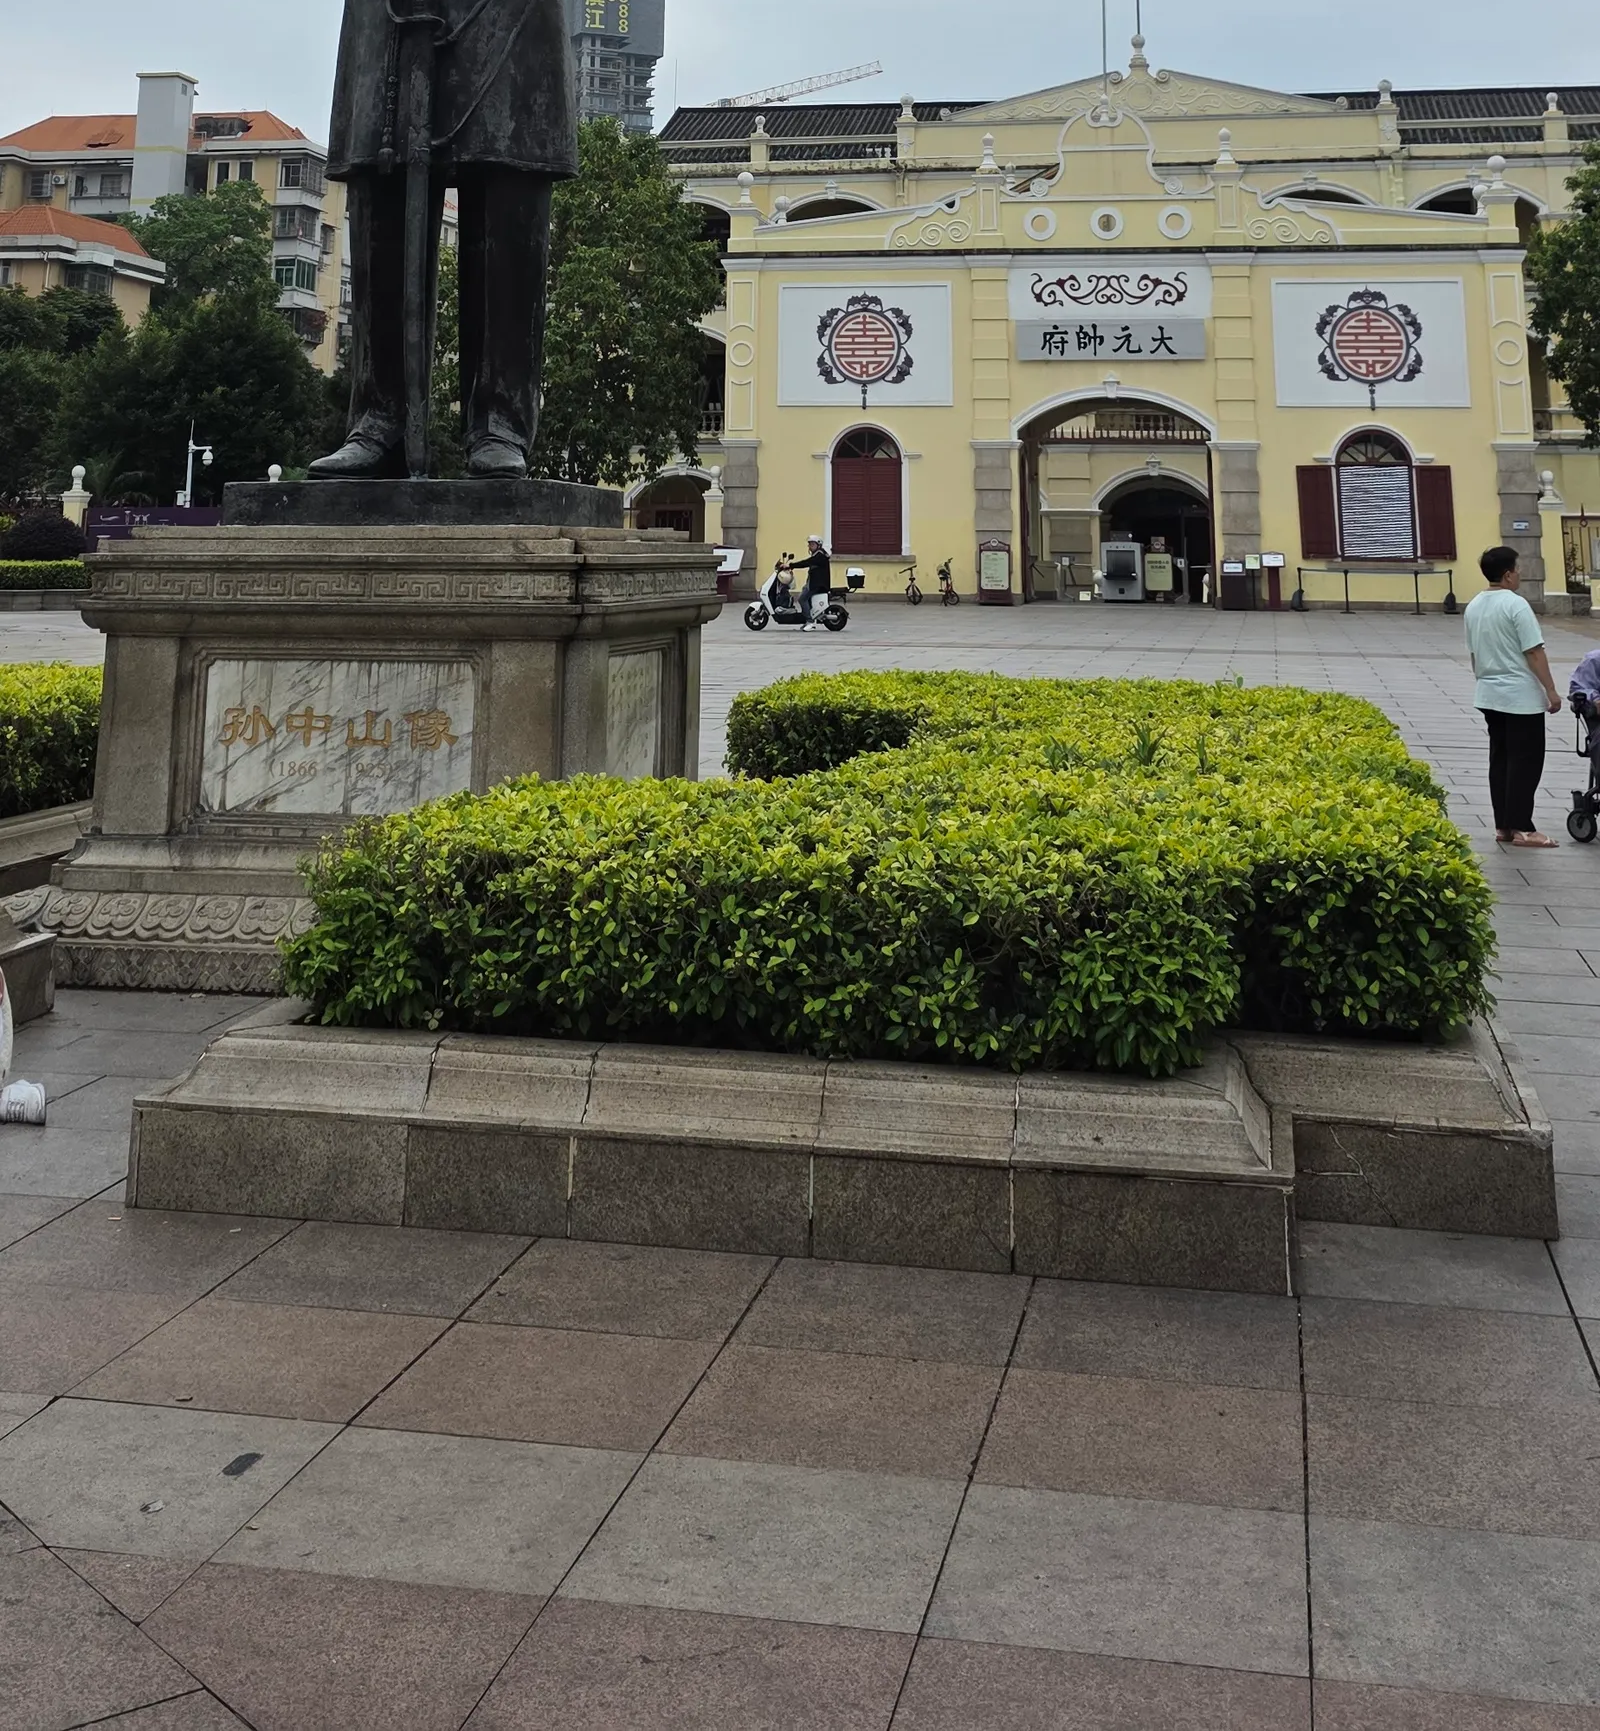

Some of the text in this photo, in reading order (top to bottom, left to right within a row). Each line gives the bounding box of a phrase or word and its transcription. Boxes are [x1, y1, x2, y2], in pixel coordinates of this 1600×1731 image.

[1041, 323, 1178, 357] 大元帥府
[219, 705, 460, 753] 孙中山像
[269, 758, 317, 778] (1866
